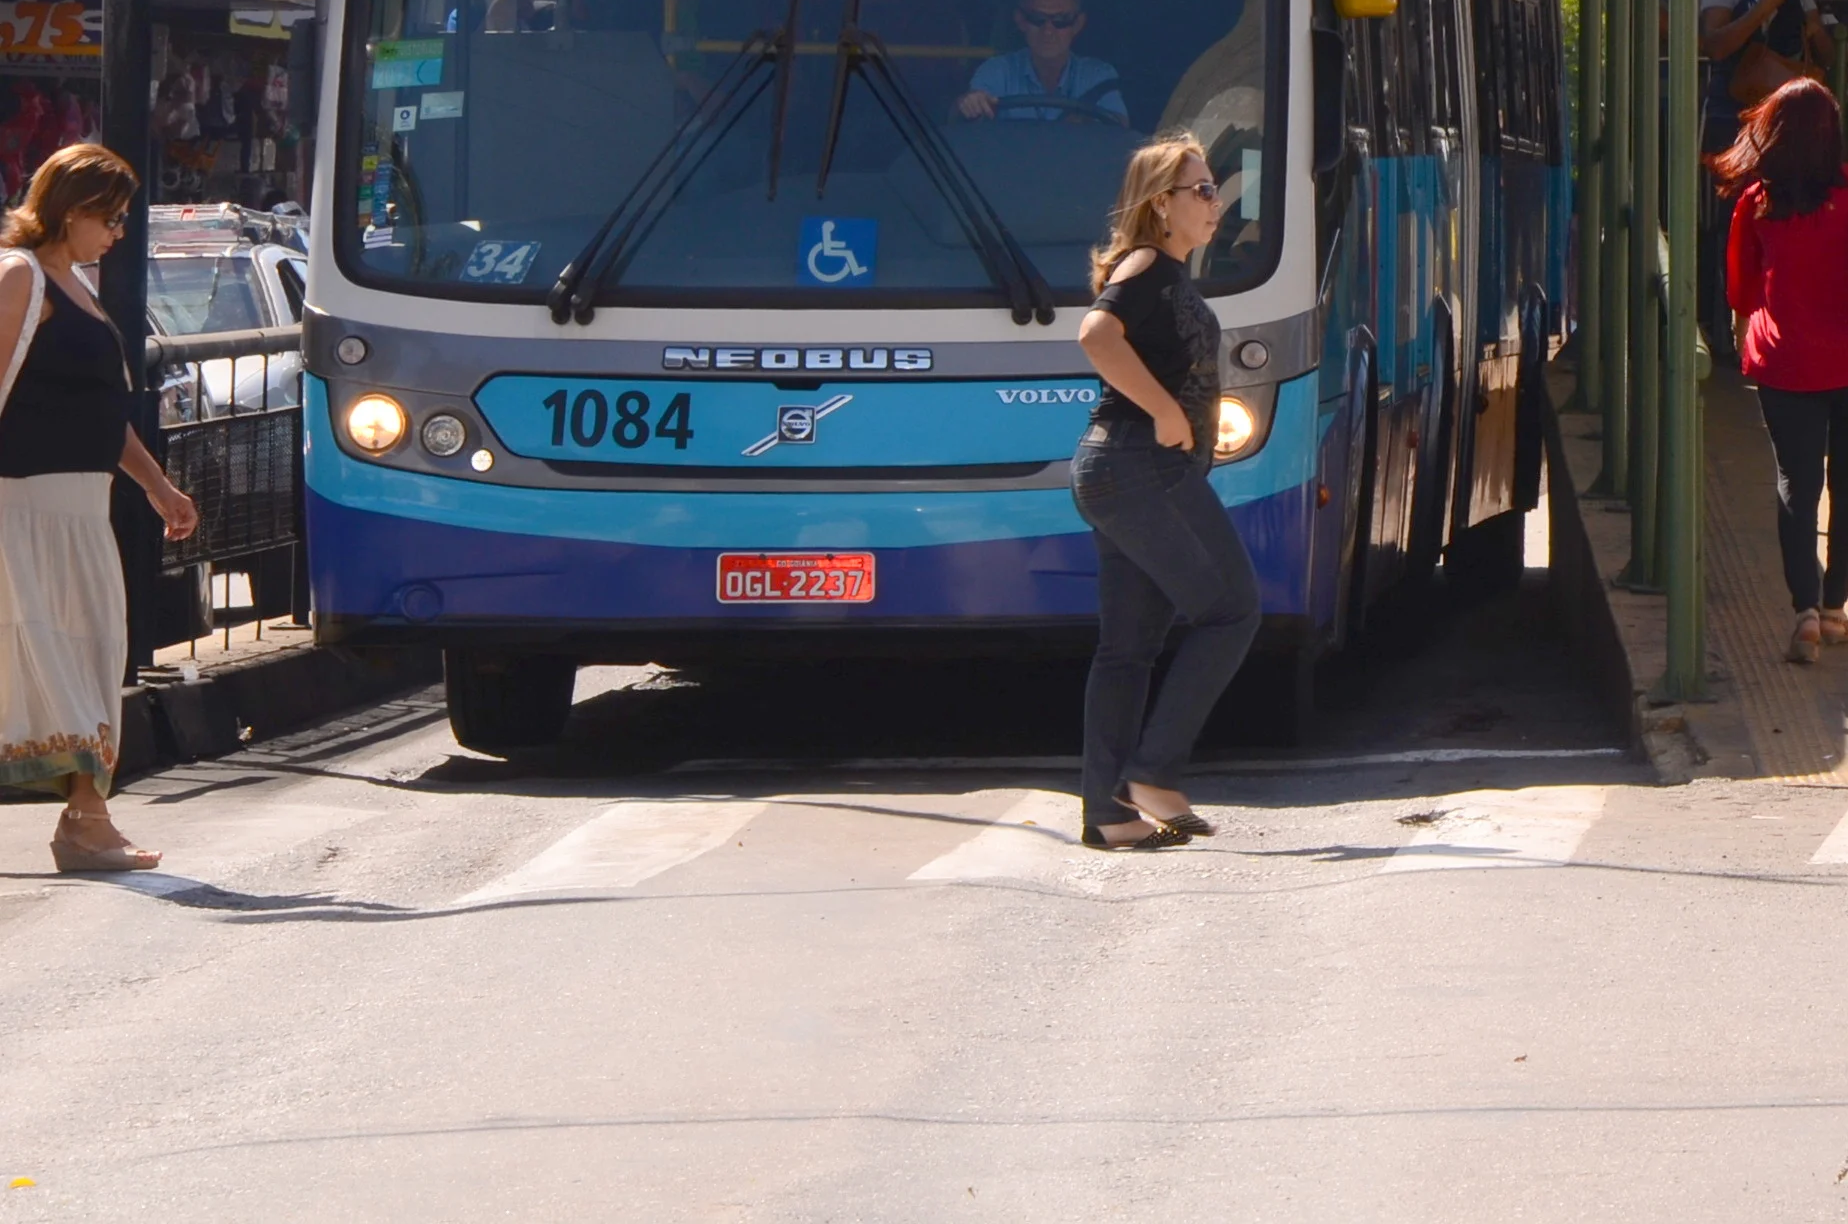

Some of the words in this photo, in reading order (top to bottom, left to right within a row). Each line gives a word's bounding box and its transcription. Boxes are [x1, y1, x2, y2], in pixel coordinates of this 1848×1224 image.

[467, 244, 531, 279] 34
[662, 347, 933, 371] NEOBUS
[994, 388, 1097, 405] VOLVO
[541, 388, 695, 450] 1084
